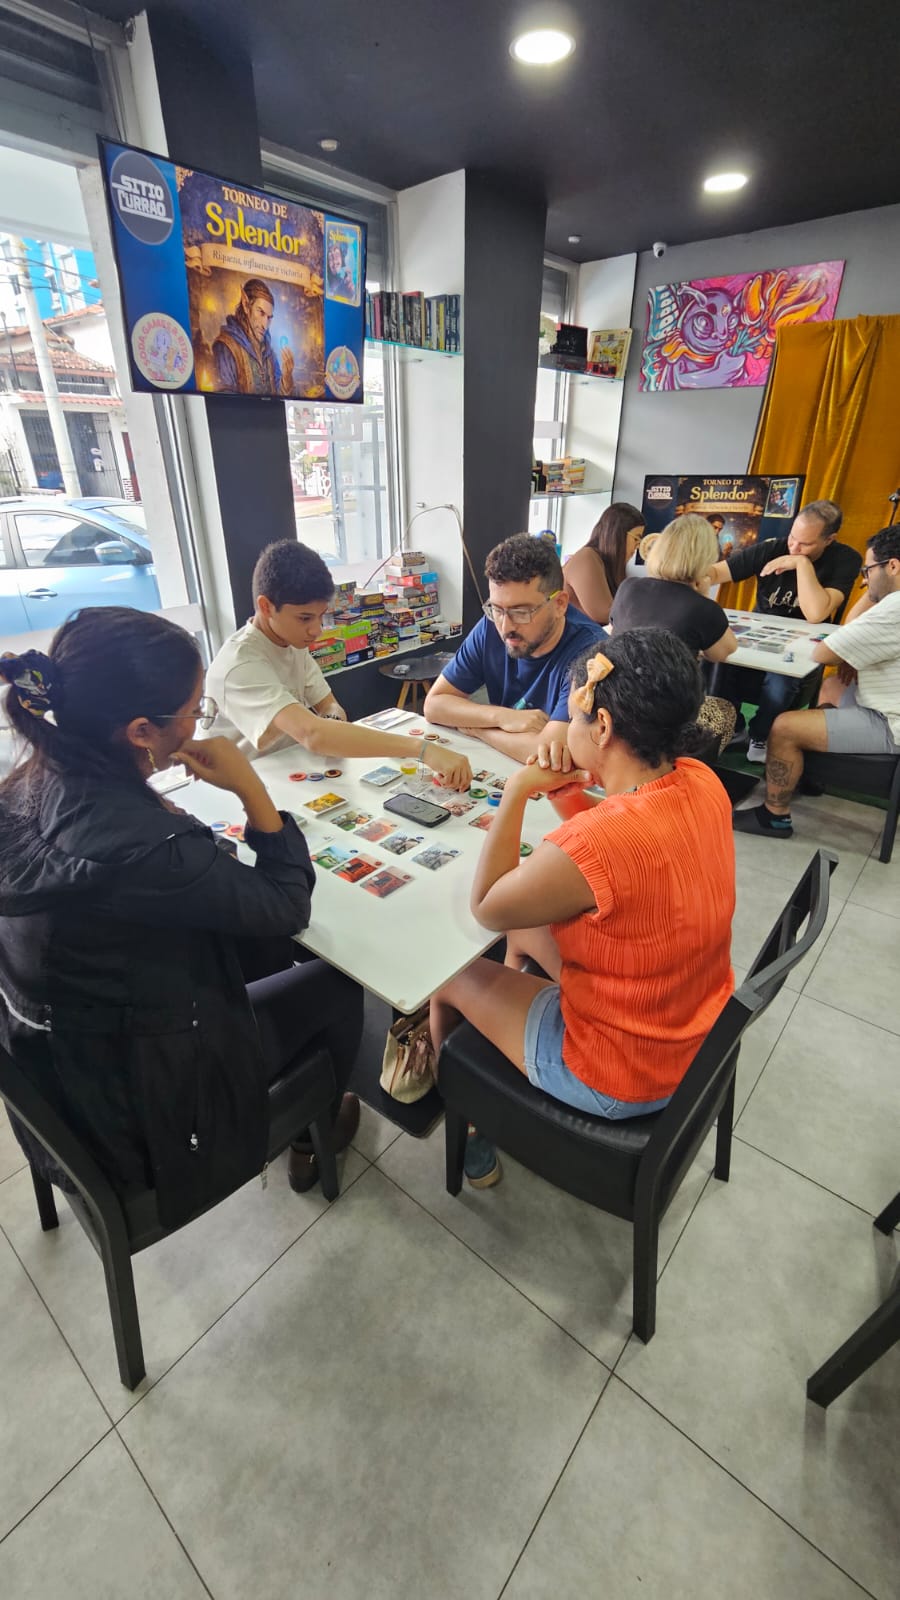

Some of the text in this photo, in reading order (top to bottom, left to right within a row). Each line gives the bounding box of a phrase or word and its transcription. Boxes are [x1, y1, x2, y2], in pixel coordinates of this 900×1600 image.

[112, 174, 164, 201] SITIO
[222, 186, 288, 218] TORNEO DE
[205, 201, 307, 256] Splendor
[690, 486, 753, 503] Splendor
